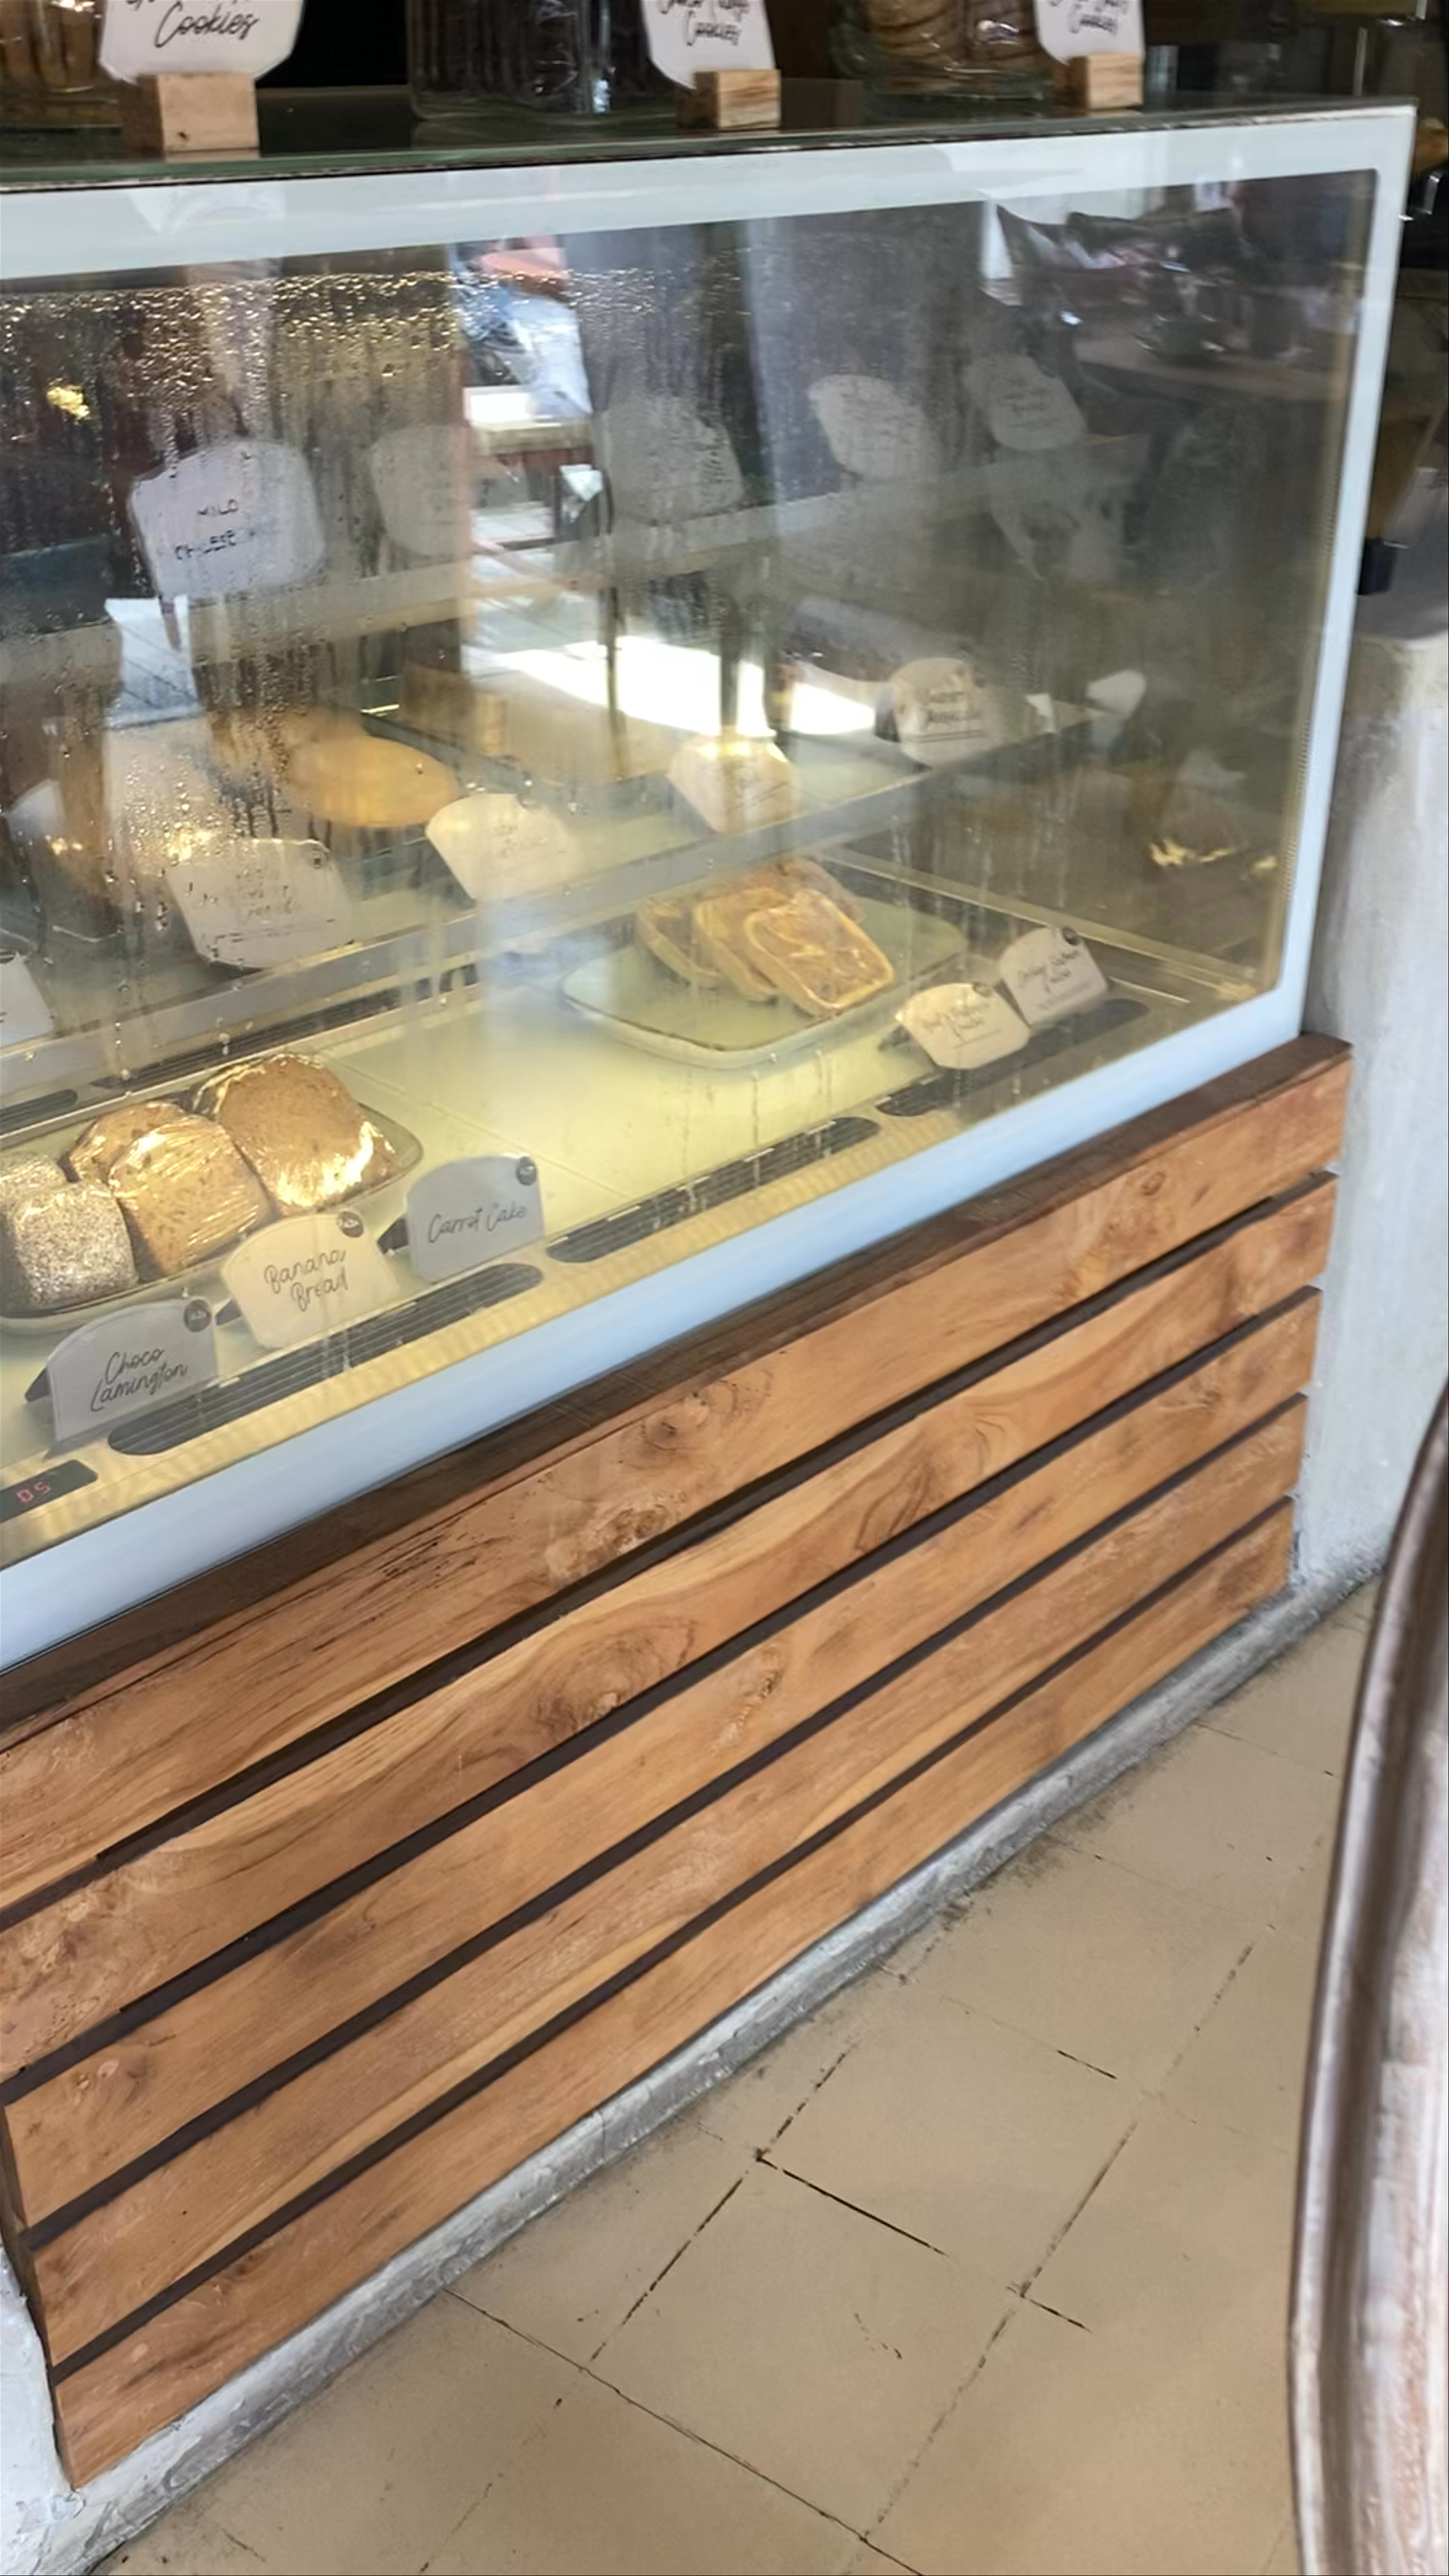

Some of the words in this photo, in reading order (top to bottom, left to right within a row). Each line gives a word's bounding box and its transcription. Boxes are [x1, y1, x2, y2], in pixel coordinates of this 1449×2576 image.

[154, 1, 259, 48] Cookies
[428, 1207, 483, 1243] Carrot
[487, 1201, 527, 1232] Cake
[265, 1250, 347, 1295] Banana
[291, 1266, 349, 1312] Bread
[90, 1361, 188, 1412] Lamington
[105, 1349, 165, 1385] Choco
